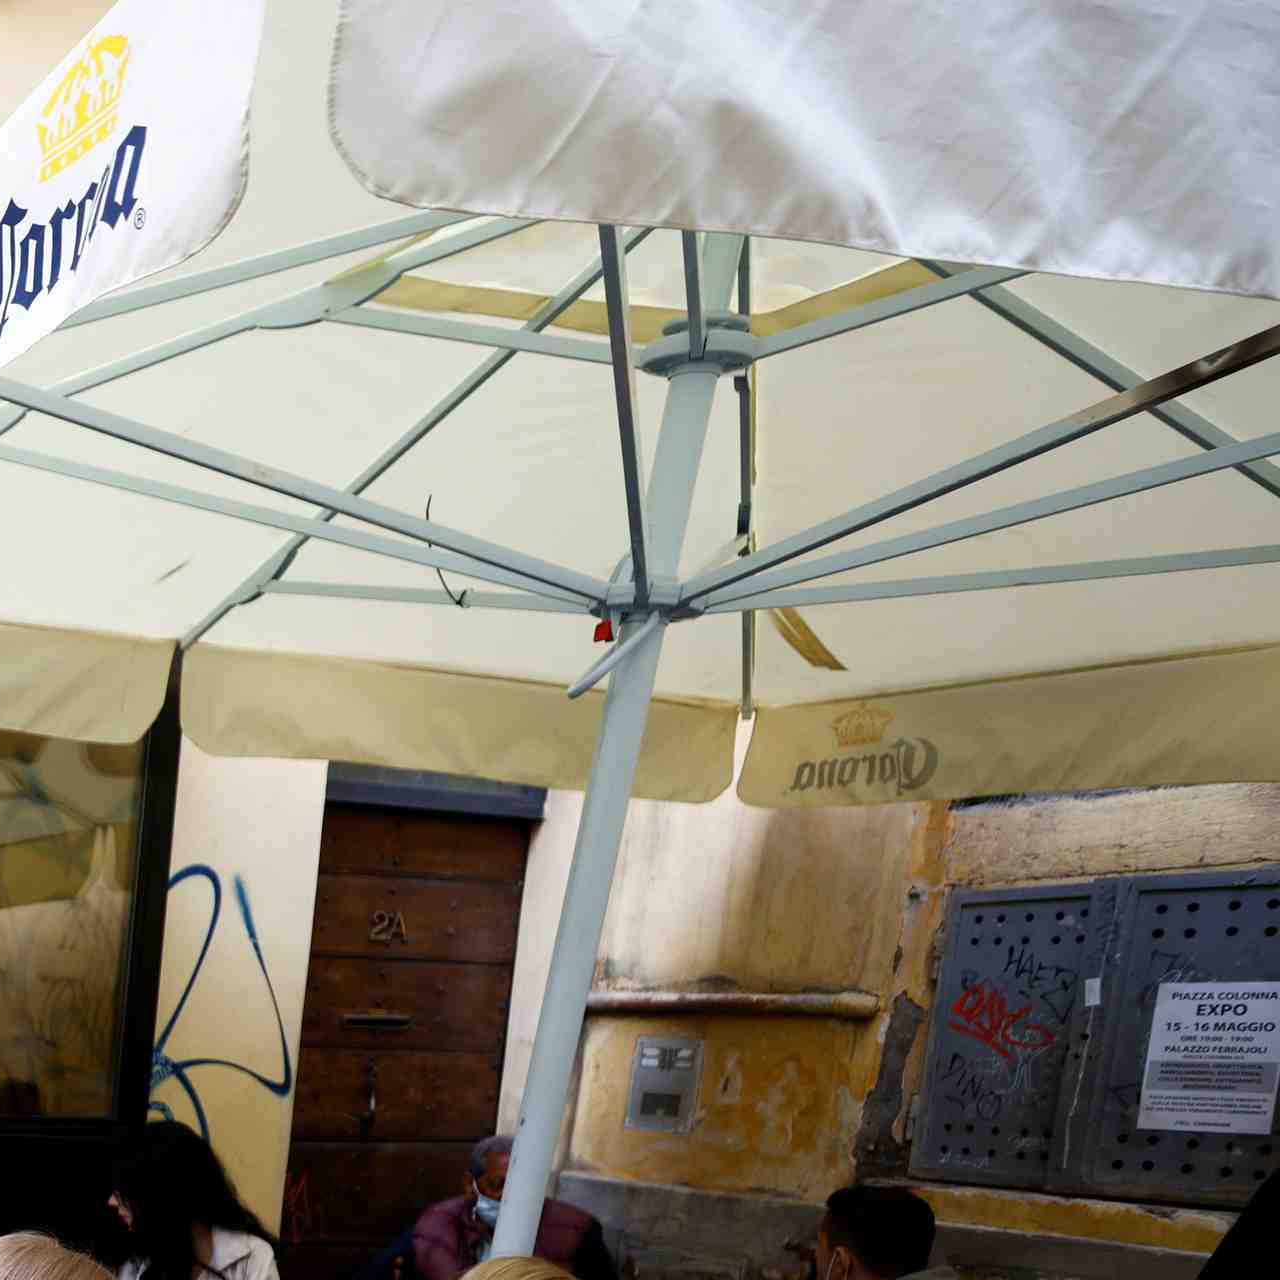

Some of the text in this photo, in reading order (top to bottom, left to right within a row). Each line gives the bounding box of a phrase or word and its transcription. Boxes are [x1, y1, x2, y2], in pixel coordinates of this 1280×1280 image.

[368, 910, 408, 942] 2A
[1172, 992, 1214, 1000] PIAZZA
[1196, 1004, 1248, 1017] EXPO
[1166, 1022, 1181, 1032] 15
[1195, 1023, 1210, 1032] 16
[1213, 1022, 1276, 1032] MAGGIO
